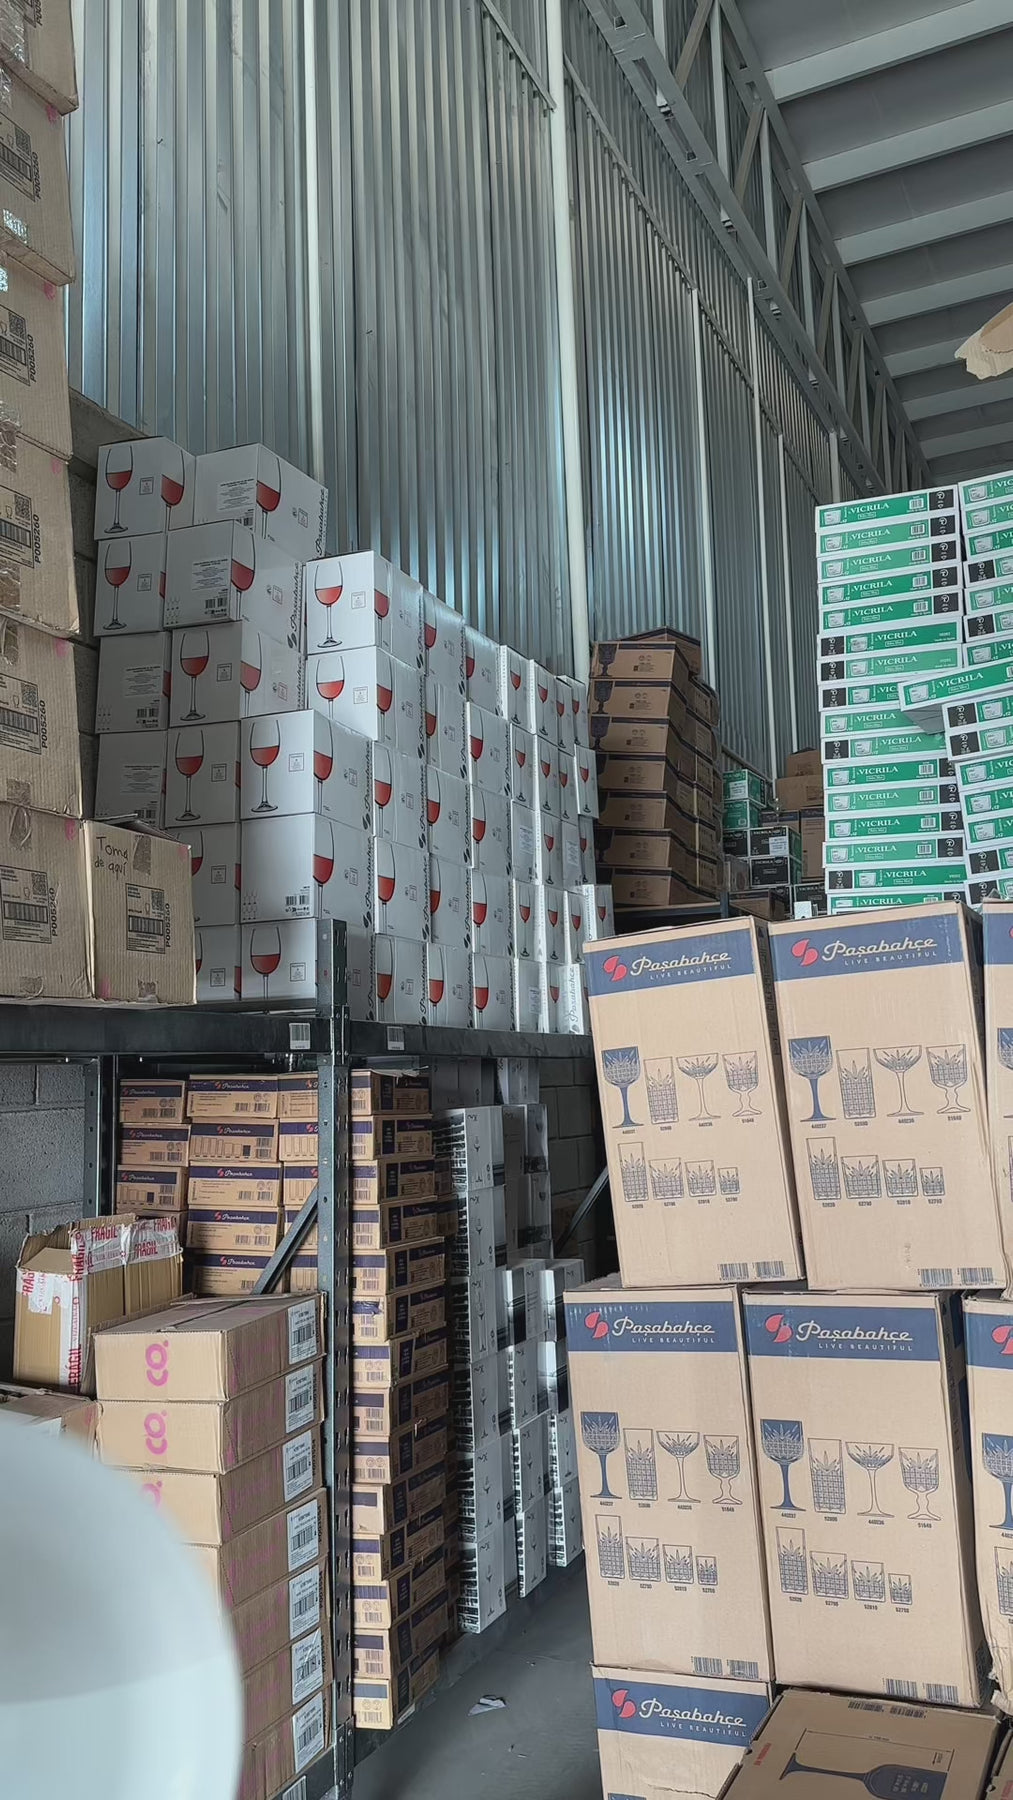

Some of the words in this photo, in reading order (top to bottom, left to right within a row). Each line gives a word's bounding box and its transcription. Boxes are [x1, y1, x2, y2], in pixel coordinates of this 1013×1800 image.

[32, 151, 42, 200] P005260
[26, 333, 37, 383] P005260
[851, 503, 890, 514] VICRILA
[32, 514, 40, 564] P005260
[851, 528, 891, 540] VICRILA
[852, 554, 892, 566] VICRILA
[853, 580, 893, 592] VICRILA
[854, 606, 894, 616] VICRILA
[877, 631, 917, 641] VICRILA
[877, 656, 918, 666] VICRILA
[938, 672, 984, 688] VICRILA
[39, 699, 48, 750] P005260
[856, 713, 896, 722] VICRILA
[881, 736, 922, 745] VICRILA
[858, 765, 899, 775] VICRILA
[859, 792, 900, 801] VICRILA
[860, 819, 900, 827] VICRILA
[96, 835, 129, 859] Toma
[857, 845, 897, 853] VICRILA
[94, 856, 105, 869] de
[108, 860, 128, 880] aquí
[886, 870, 927, 878] VICRILA
[48, 887, 58, 937] P005260
[822, 937, 938, 961] Paşabahçe
[630, 952, 732, 976] Paşabahçe
[844, 958, 868, 966] LIVE
[875, 951, 937, 962] BEAUTIFUL
[650, 972, 672, 980] LIVE
[677, 964, 732, 976] BEAUTIFUL
[612, 1316, 715, 1336] Paşabahçe
[796, 1320, 913, 1344] Paşabahçe
[638, 1697, 747, 1728] Paşabahçe
[660, 1722, 683, 1730] LIVE
[689, 1725, 746, 1737] BEAUTIFUL
